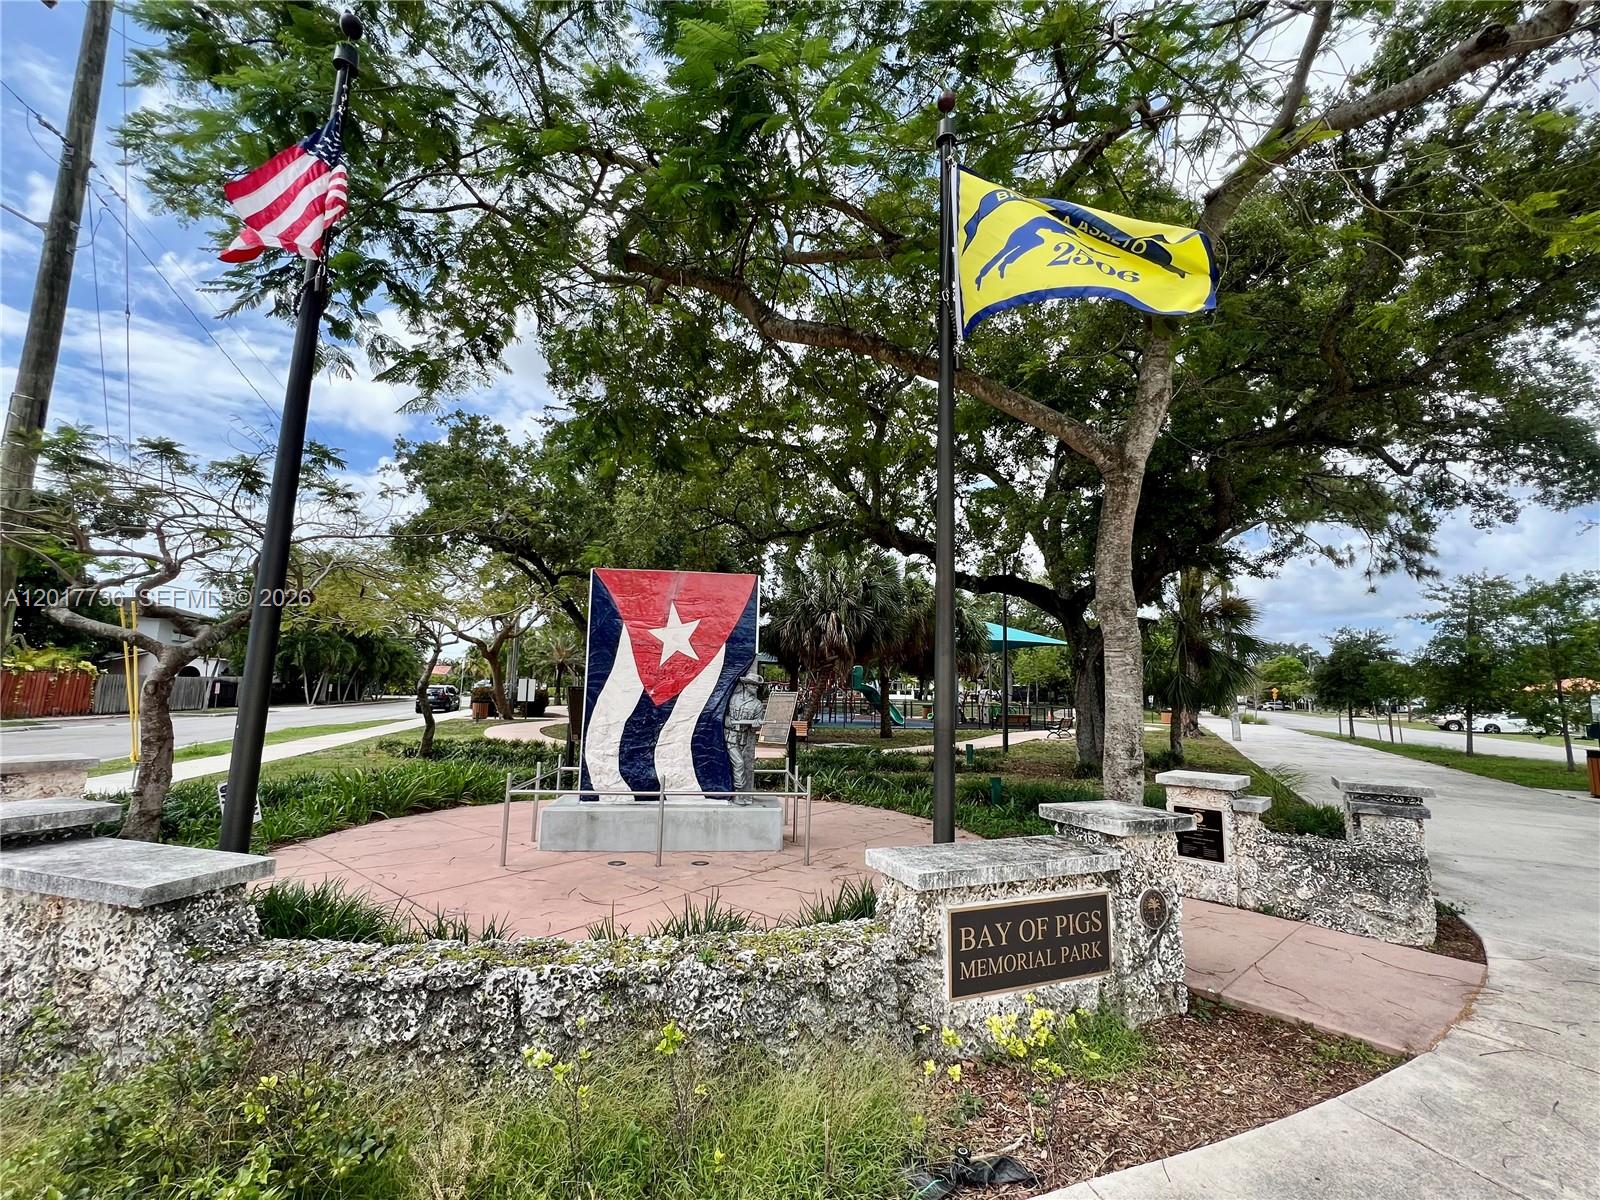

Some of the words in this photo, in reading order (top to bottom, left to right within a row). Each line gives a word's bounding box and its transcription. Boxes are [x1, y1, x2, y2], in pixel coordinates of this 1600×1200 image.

[1047, 242, 1140, 282] 2506
[960, 921, 1012, 952] BAY
[1018, 916, 1048, 942] OF
[1056, 910, 1103, 938] PIGS
[959, 949, 1056, 981] MEMORIAL
[1061, 940, 1103, 964] PARK
